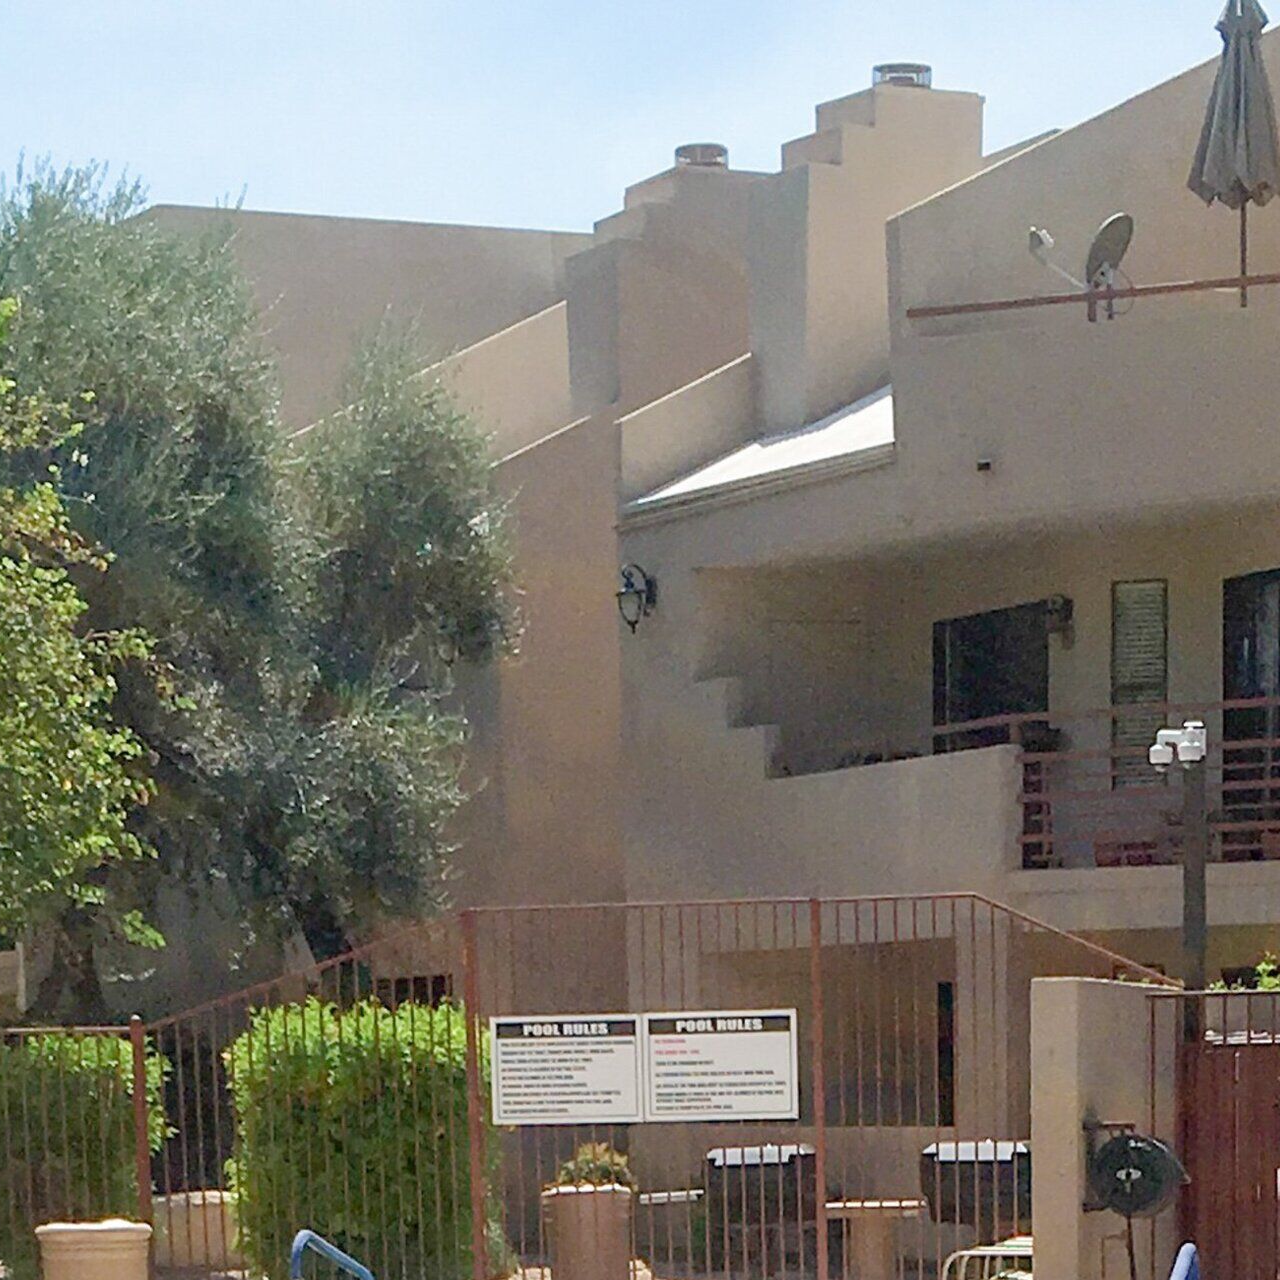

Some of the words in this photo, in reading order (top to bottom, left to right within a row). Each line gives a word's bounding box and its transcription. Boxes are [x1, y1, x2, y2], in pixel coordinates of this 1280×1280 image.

[523, 1023, 560, 1036] POOL
[562, 1022, 608, 1036] RULES
[675, 1020, 715, 1032] POOL
[716, 1018, 763, 1031] RULES
